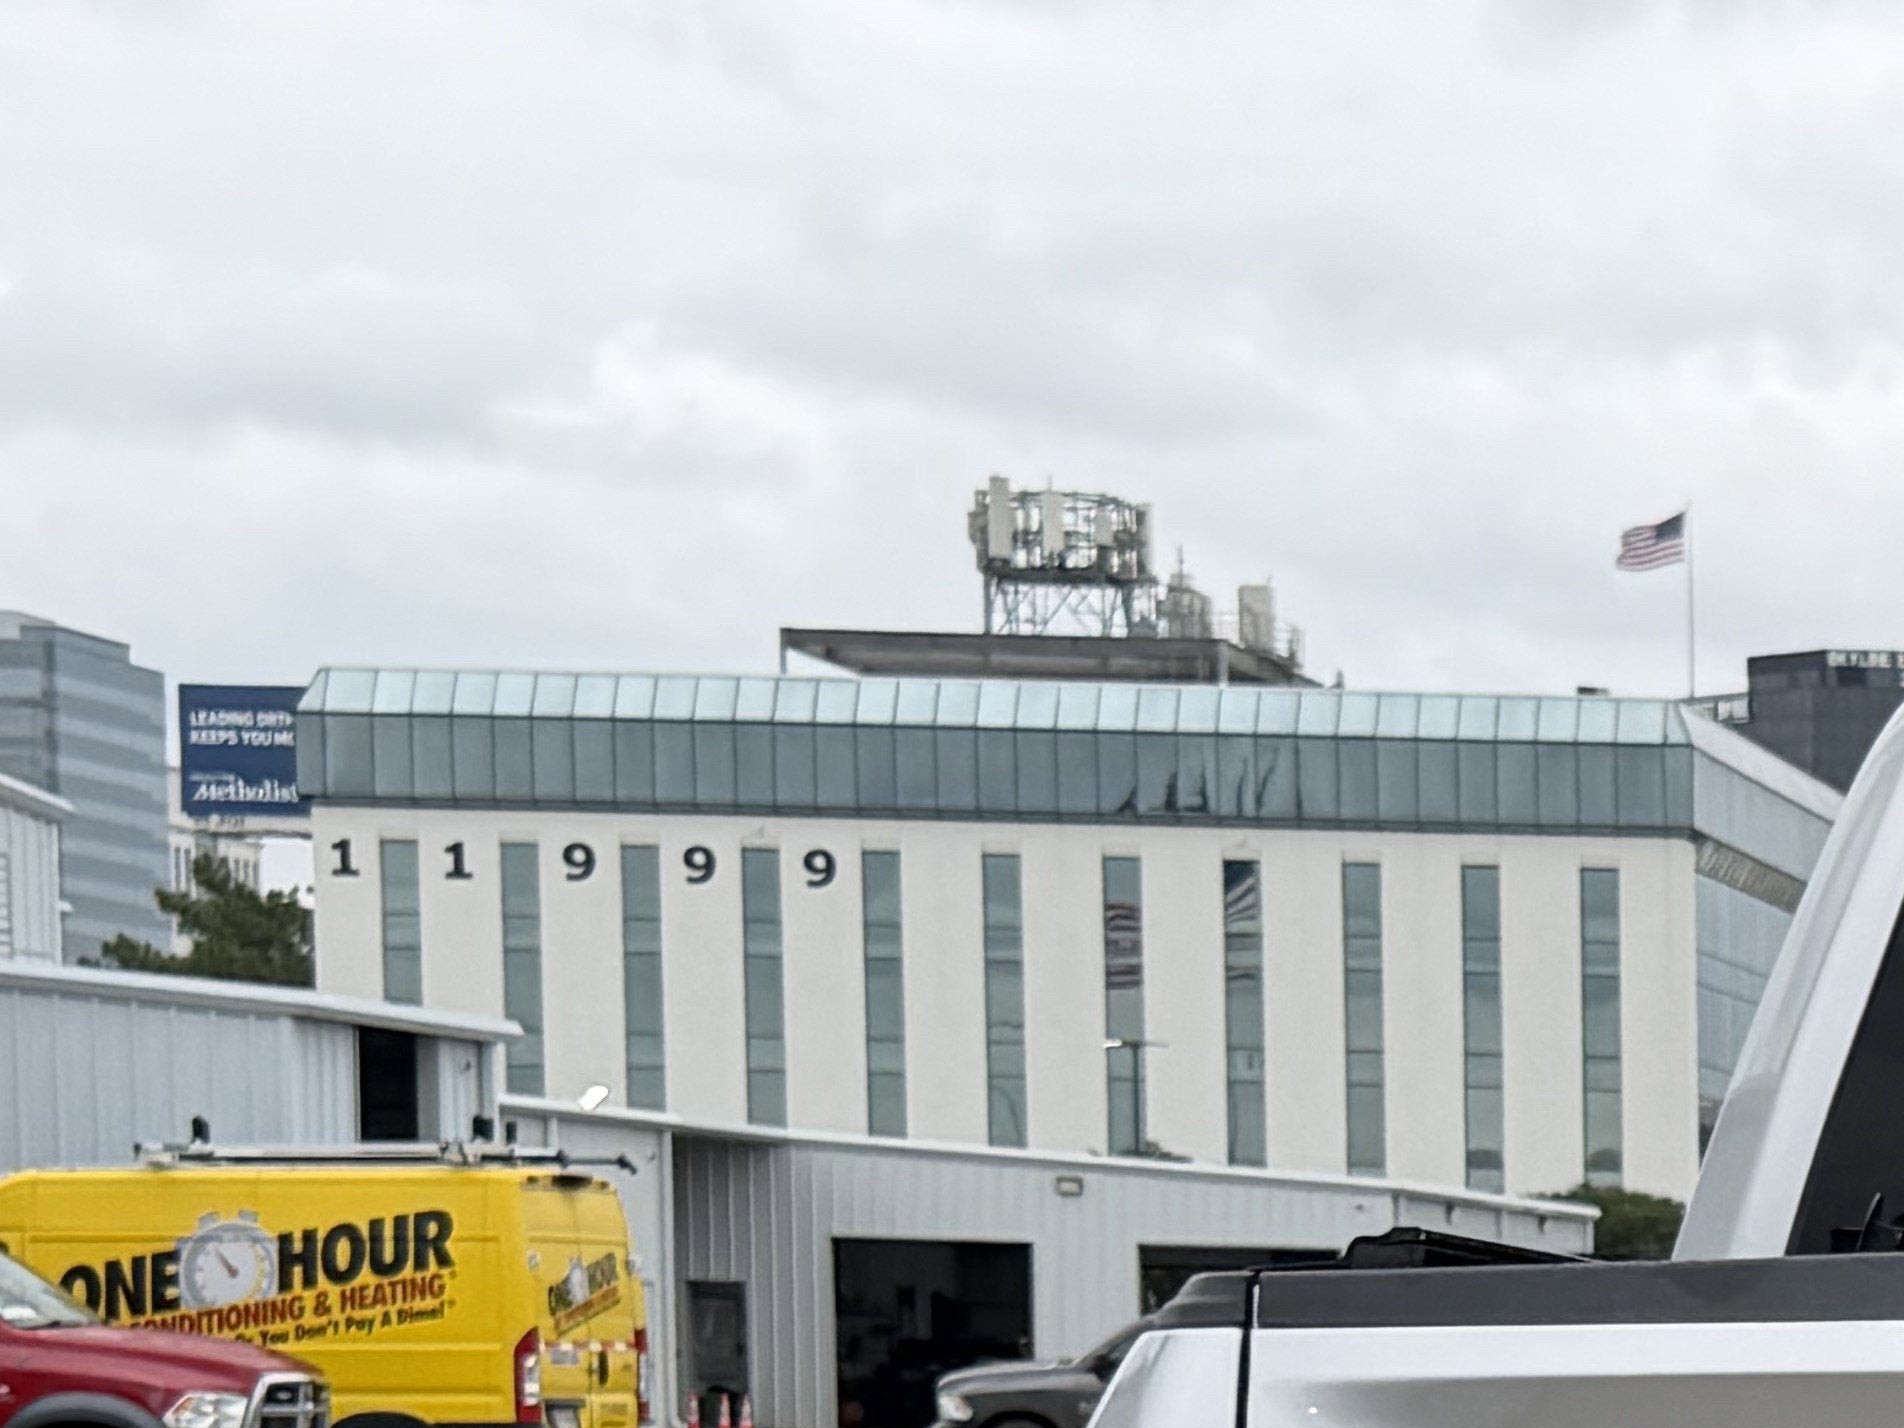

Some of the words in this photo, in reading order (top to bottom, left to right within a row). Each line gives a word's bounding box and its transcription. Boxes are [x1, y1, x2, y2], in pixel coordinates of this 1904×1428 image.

[189, 730, 239, 745] KEEPS
[241, 731, 273, 746] YOU
[59, 1250, 182, 1322] ONE
[277, 1210, 456, 1293] HOUR
[313, 1290, 331, 1317] &
[341, 1273, 446, 1313] HEATING
[259, 1329, 289, 1346] You
[381, 1310, 392, 1326] A
